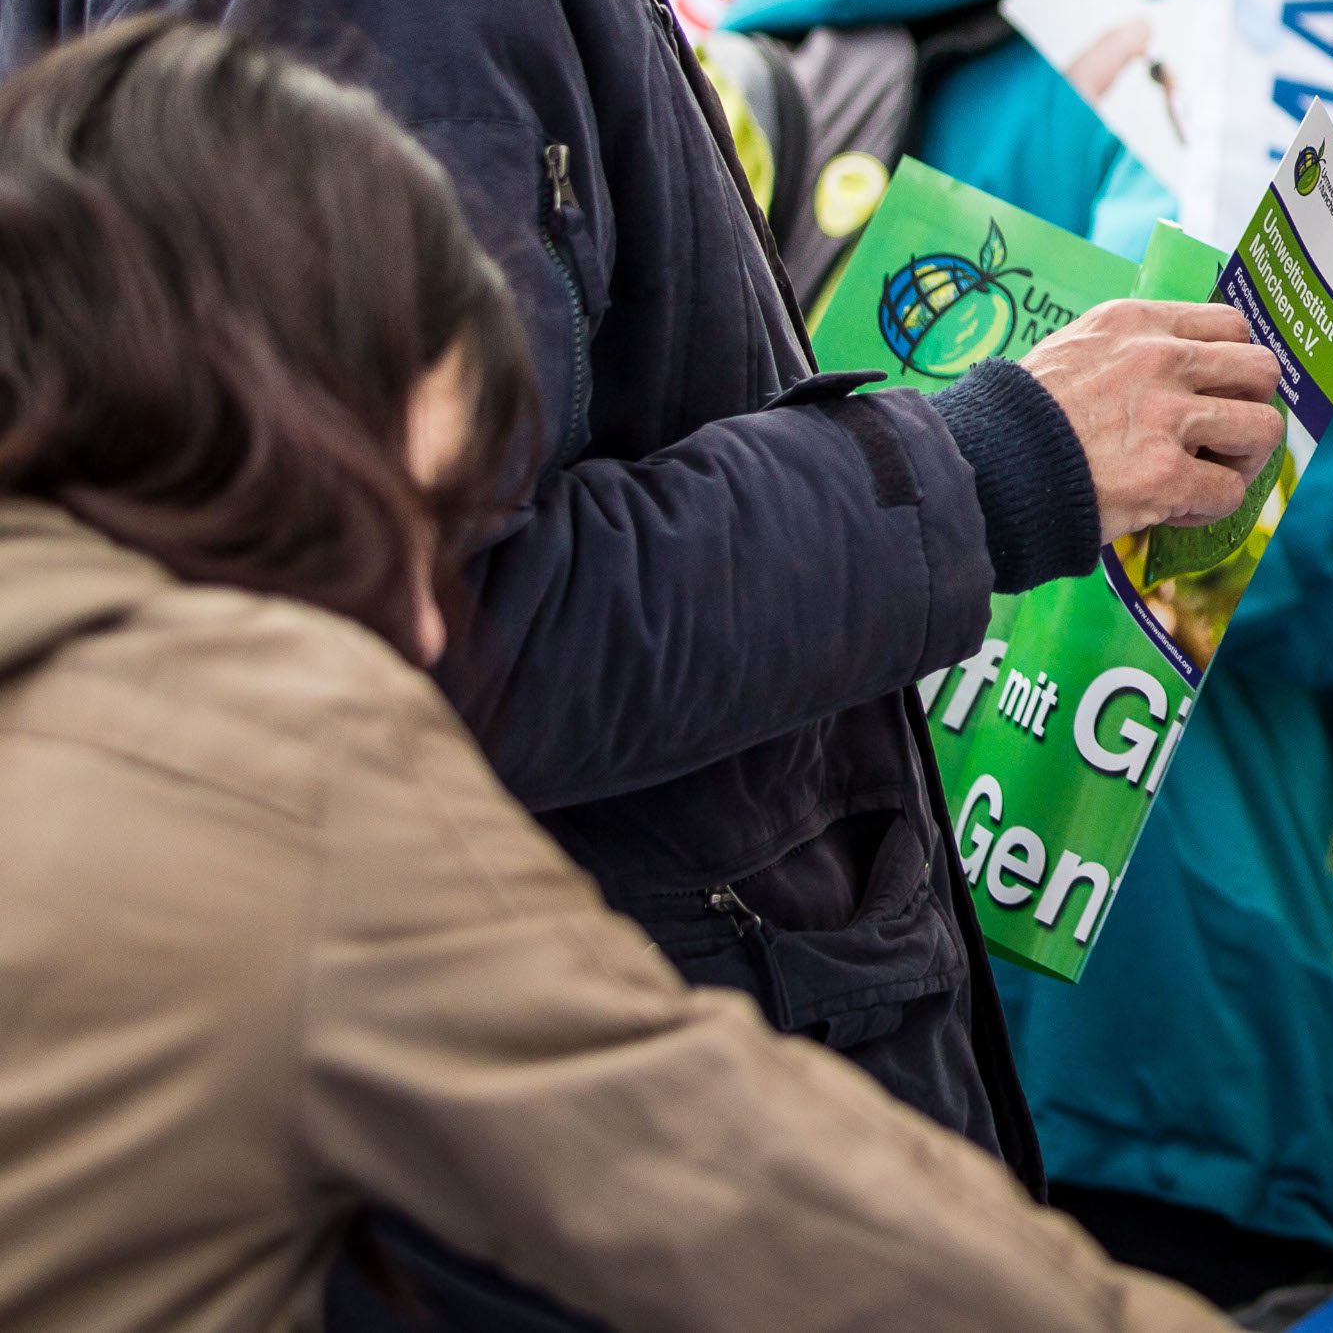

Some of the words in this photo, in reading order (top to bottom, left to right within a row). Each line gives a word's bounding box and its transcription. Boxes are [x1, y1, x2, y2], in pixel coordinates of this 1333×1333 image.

[1227, 282, 1237, 299] für
[1278, 375, 1301, 406] mwelt
[1234, 267, 1259, 318] Forschung
[1257, 313, 1270, 335] und
[1267, 330, 1301, 385] Aufklärung
[1249, 233, 1294, 325] München
[1293, 322, 1314, 357] e.V.
[1134, 601, 1193, 675] www.umweltinstitut.org
[998, 667, 1060, 738] mit
